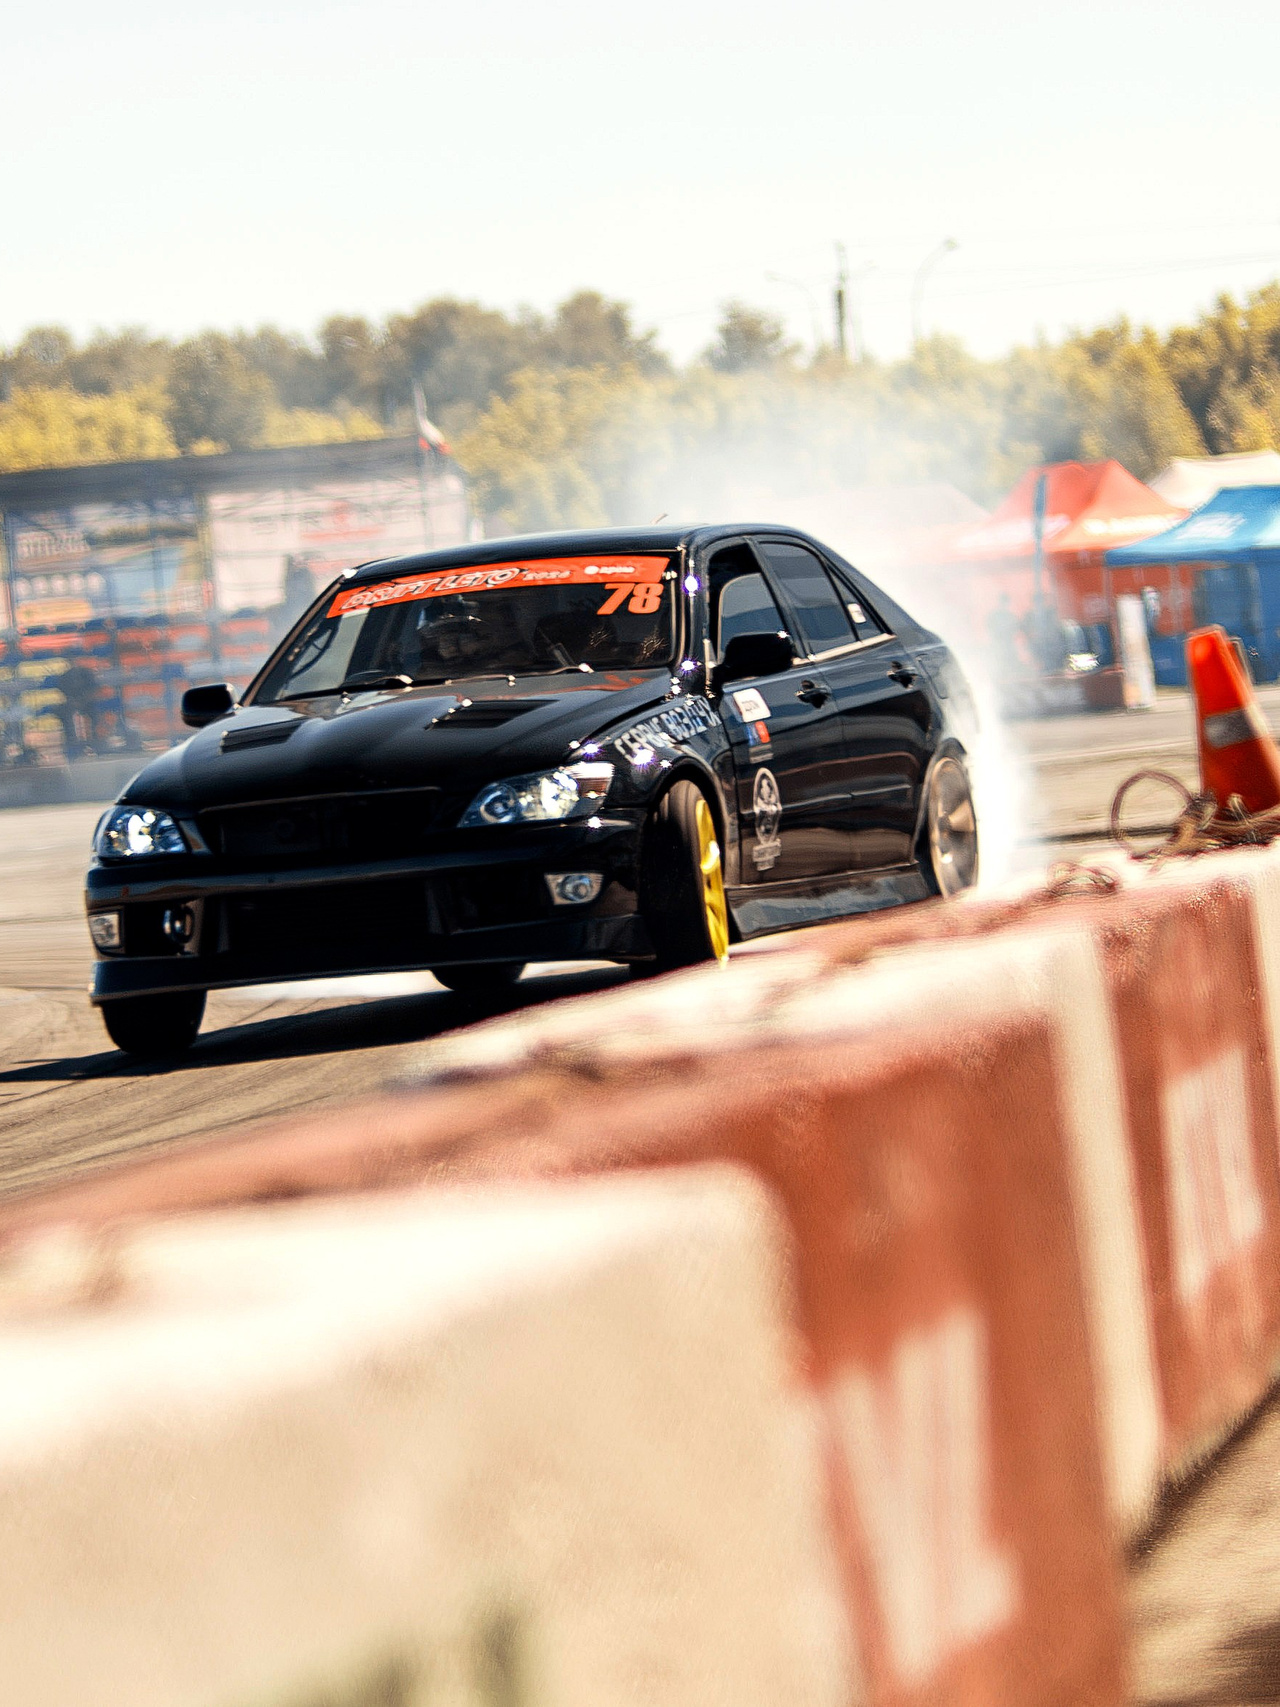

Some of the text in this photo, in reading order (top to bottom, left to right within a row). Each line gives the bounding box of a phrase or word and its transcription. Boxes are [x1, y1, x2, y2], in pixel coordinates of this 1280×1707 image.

[341, 578, 441, 610] DRIFT
[435, 567, 521, 591] LETO
[597, 582, 664, 615] 78
